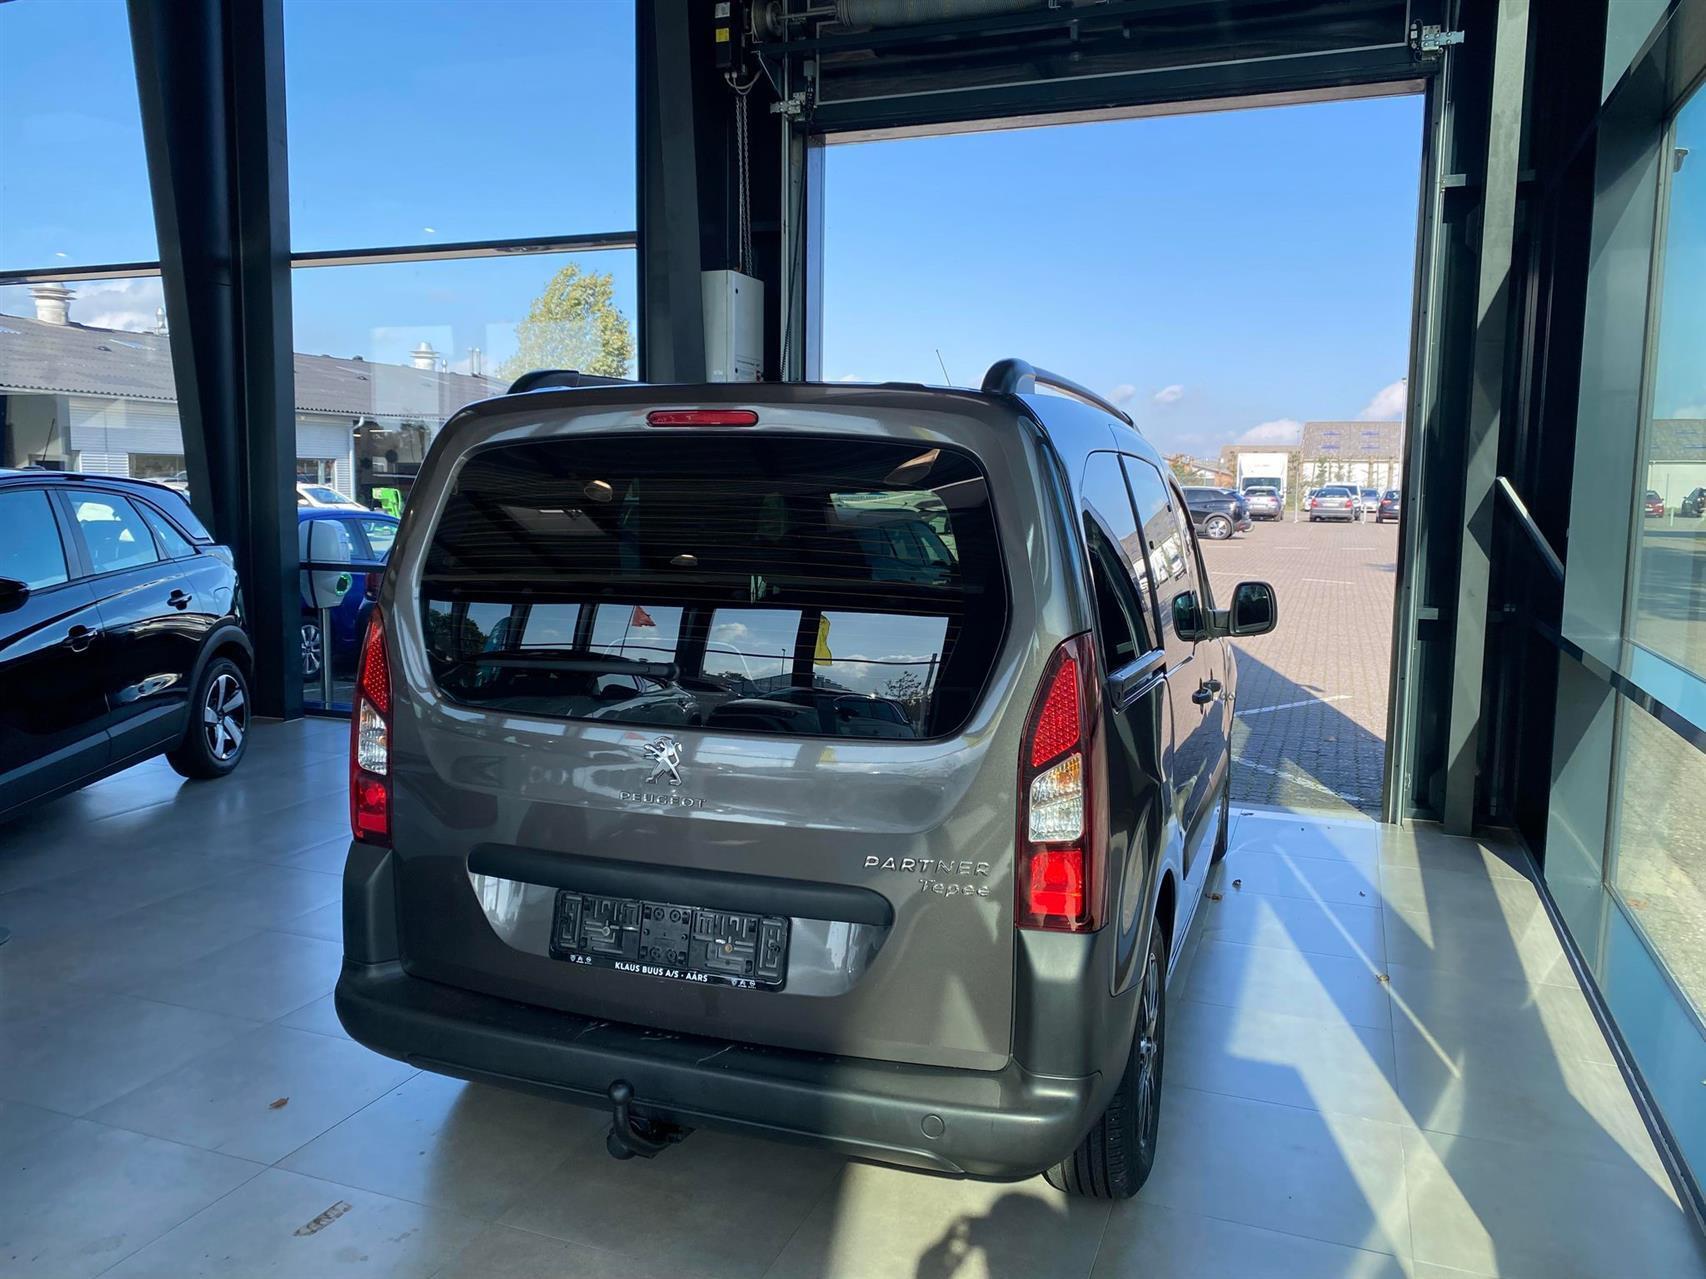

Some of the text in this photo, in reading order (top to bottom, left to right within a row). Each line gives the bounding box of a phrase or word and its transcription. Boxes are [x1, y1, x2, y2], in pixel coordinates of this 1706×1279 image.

[619, 790, 707, 808] PEUGEOT
[863, 855, 991, 877] PARTNER
[919, 879, 990, 898] Tepee
[614, 961, 641, 973] KLAUS
[641, 965, 664, 976] BUUS
[664, 969, 680, 979] A/S
